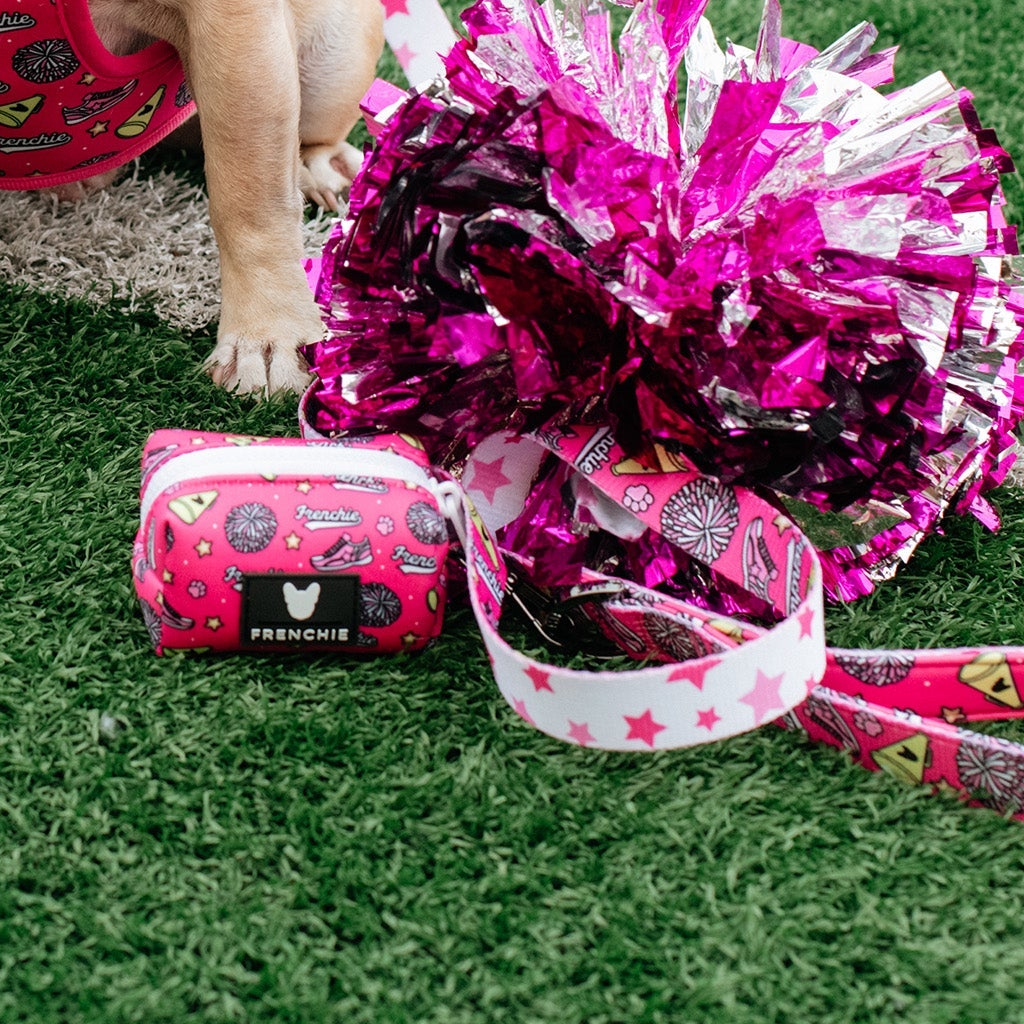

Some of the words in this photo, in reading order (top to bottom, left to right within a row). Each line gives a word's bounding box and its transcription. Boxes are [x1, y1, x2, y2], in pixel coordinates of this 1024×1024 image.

[579, 432, 615, 475] nchie
[295, 504, 362, 523] Frenchie
[250, 628, 349, 641] FRENCHIE
